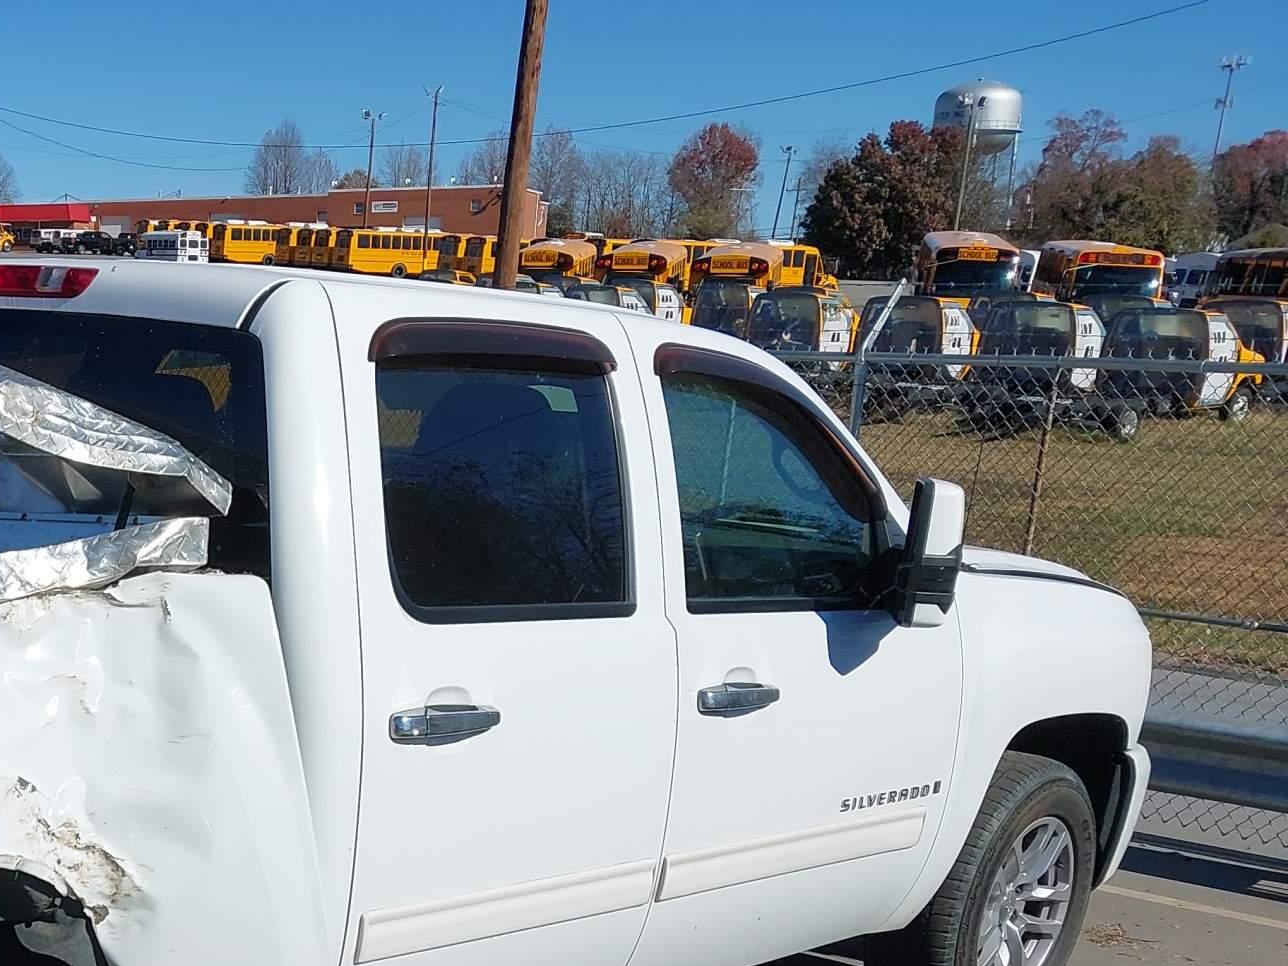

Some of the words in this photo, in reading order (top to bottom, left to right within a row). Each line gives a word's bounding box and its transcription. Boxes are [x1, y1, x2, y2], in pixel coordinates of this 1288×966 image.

[958, 250, 984, 260] SCHOOL
[984, 251, 998, 261] BUS
[614, 256, 636, 266] SCHOOL
[637, 256, 648, 266] BUS
[711, 260, 735, 270] SCHOOL
[736, 260, 748, 270] BUS
[839, 783, 931, 813] SILVERADO
